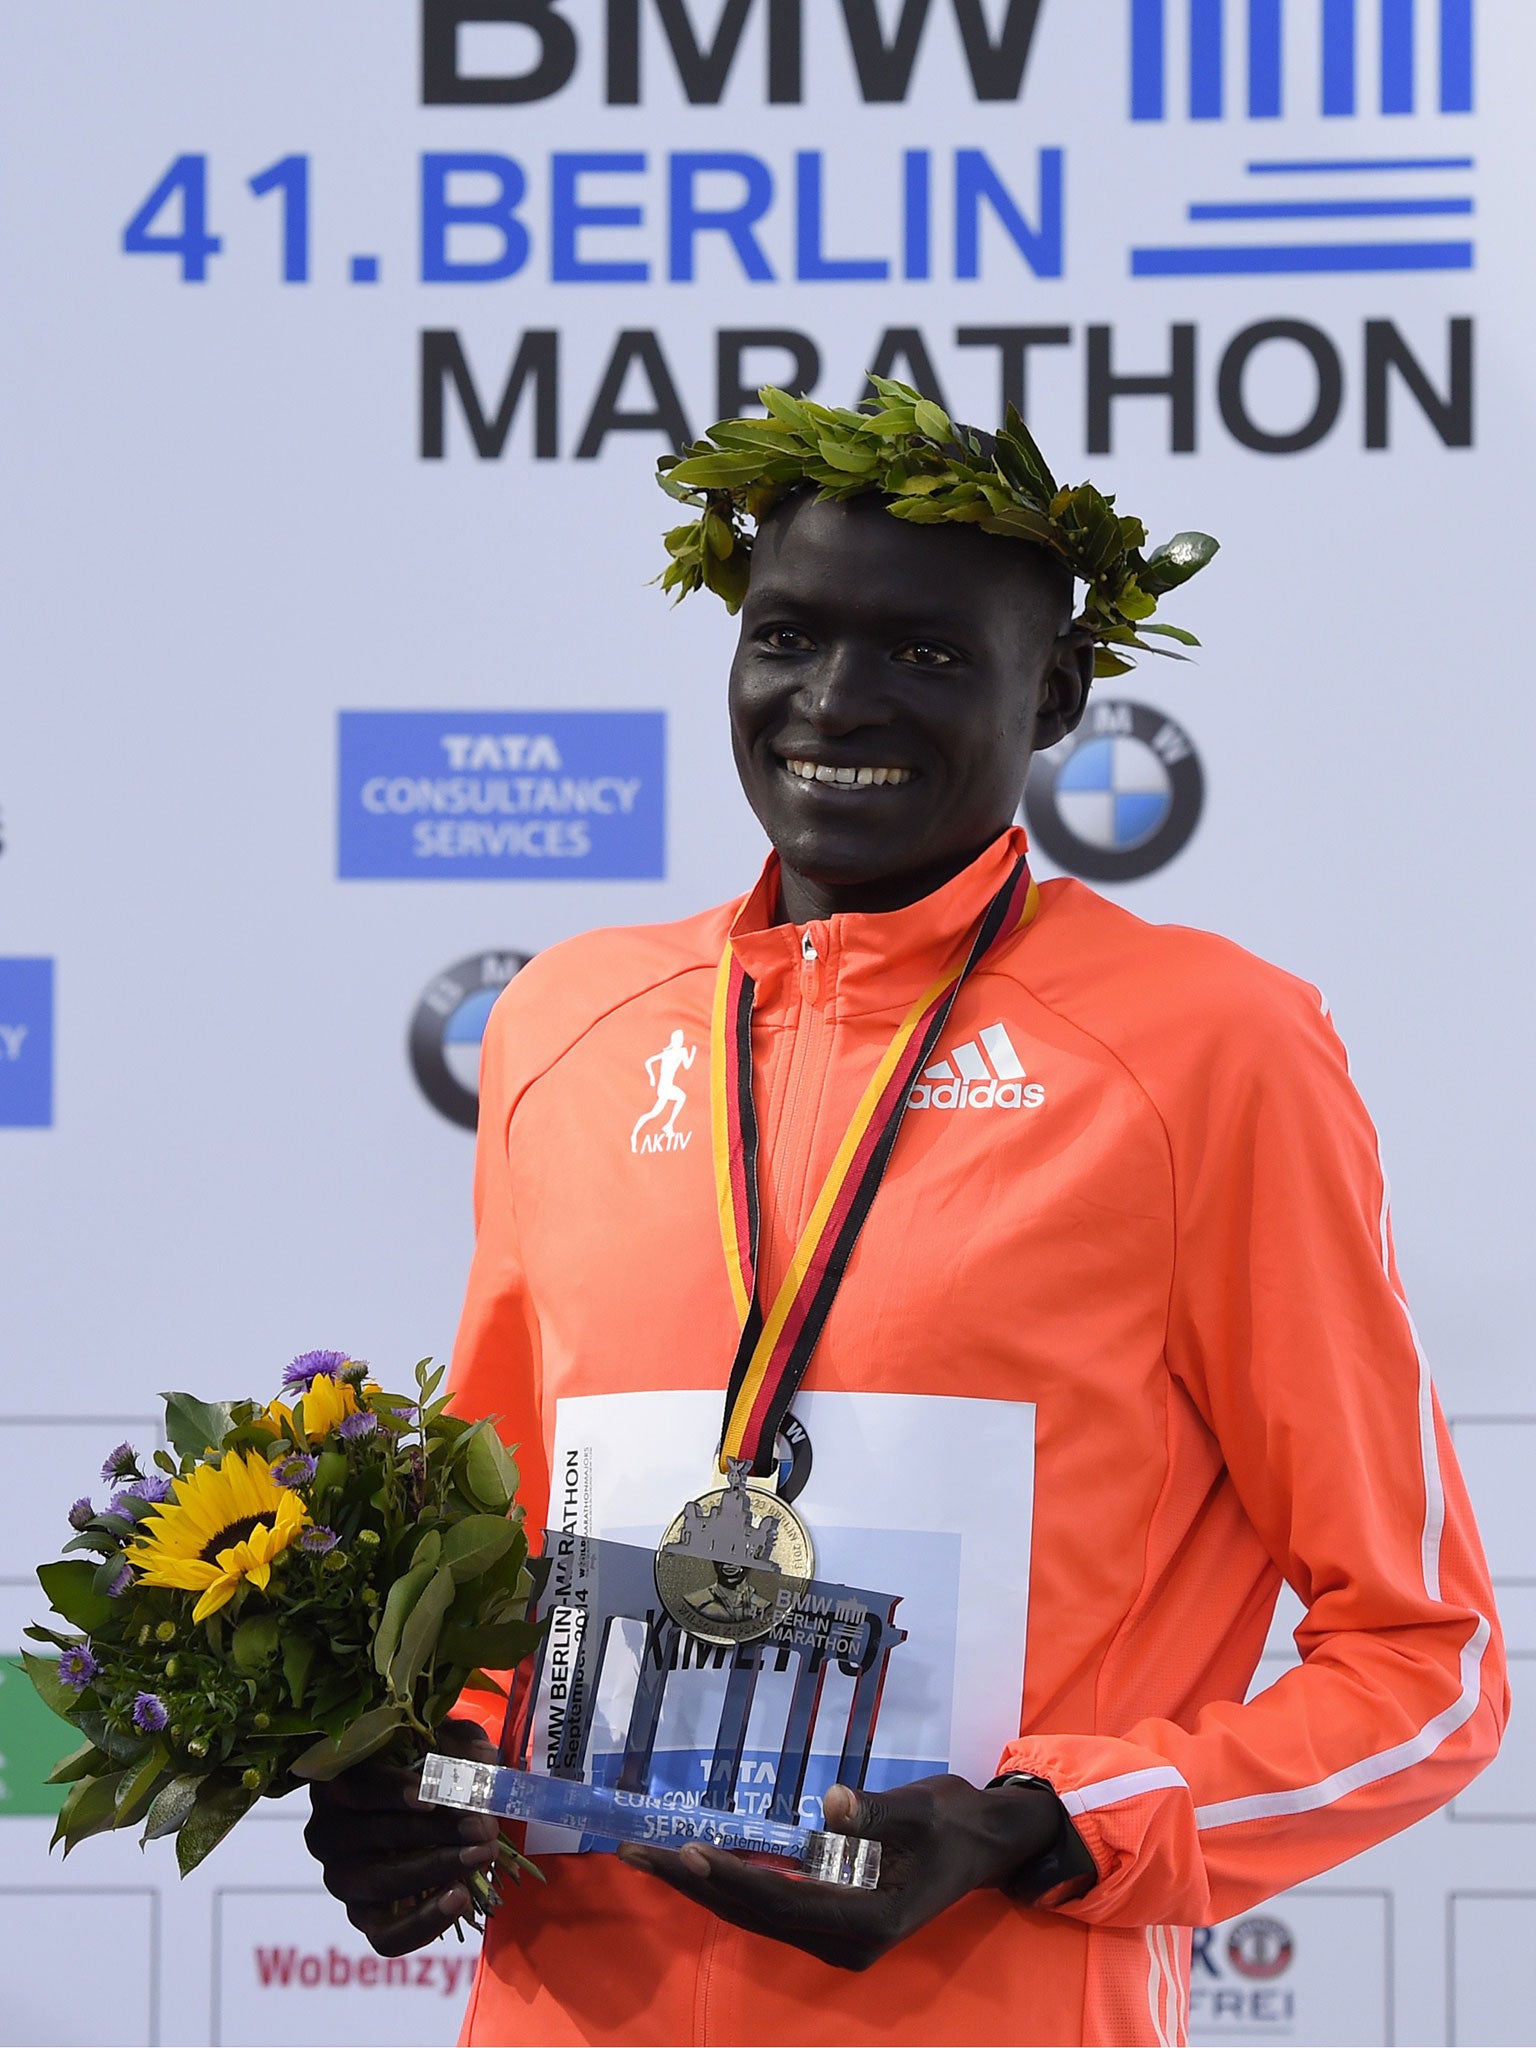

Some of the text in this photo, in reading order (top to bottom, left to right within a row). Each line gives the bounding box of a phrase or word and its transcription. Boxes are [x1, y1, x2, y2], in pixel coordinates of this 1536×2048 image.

[420, 0, 1042, 106] BMW
[121, 146, 1065, 284] 41. BERLIN
[419, 316, 1475, 462] MARATHON
[441, 735, 562, 770] TATA
[361, 777, 641, 814] CONSULTANCY
[413, 820, 591, 858] SERVICES
[907, 1078, 1045, 1109] adidas
[640, 1131, 692, 1154] AKTIV
[775, 1589, 833, 1616] BMW
[772, 1610, 830, 1633] BERLIN
[769, 1626, 860, 1656] MARATHON
[700, 1759, 776, 1784] TATA
[675, 1820, 699, 1839] 28.
[704, 1826, 788, 1856] September
